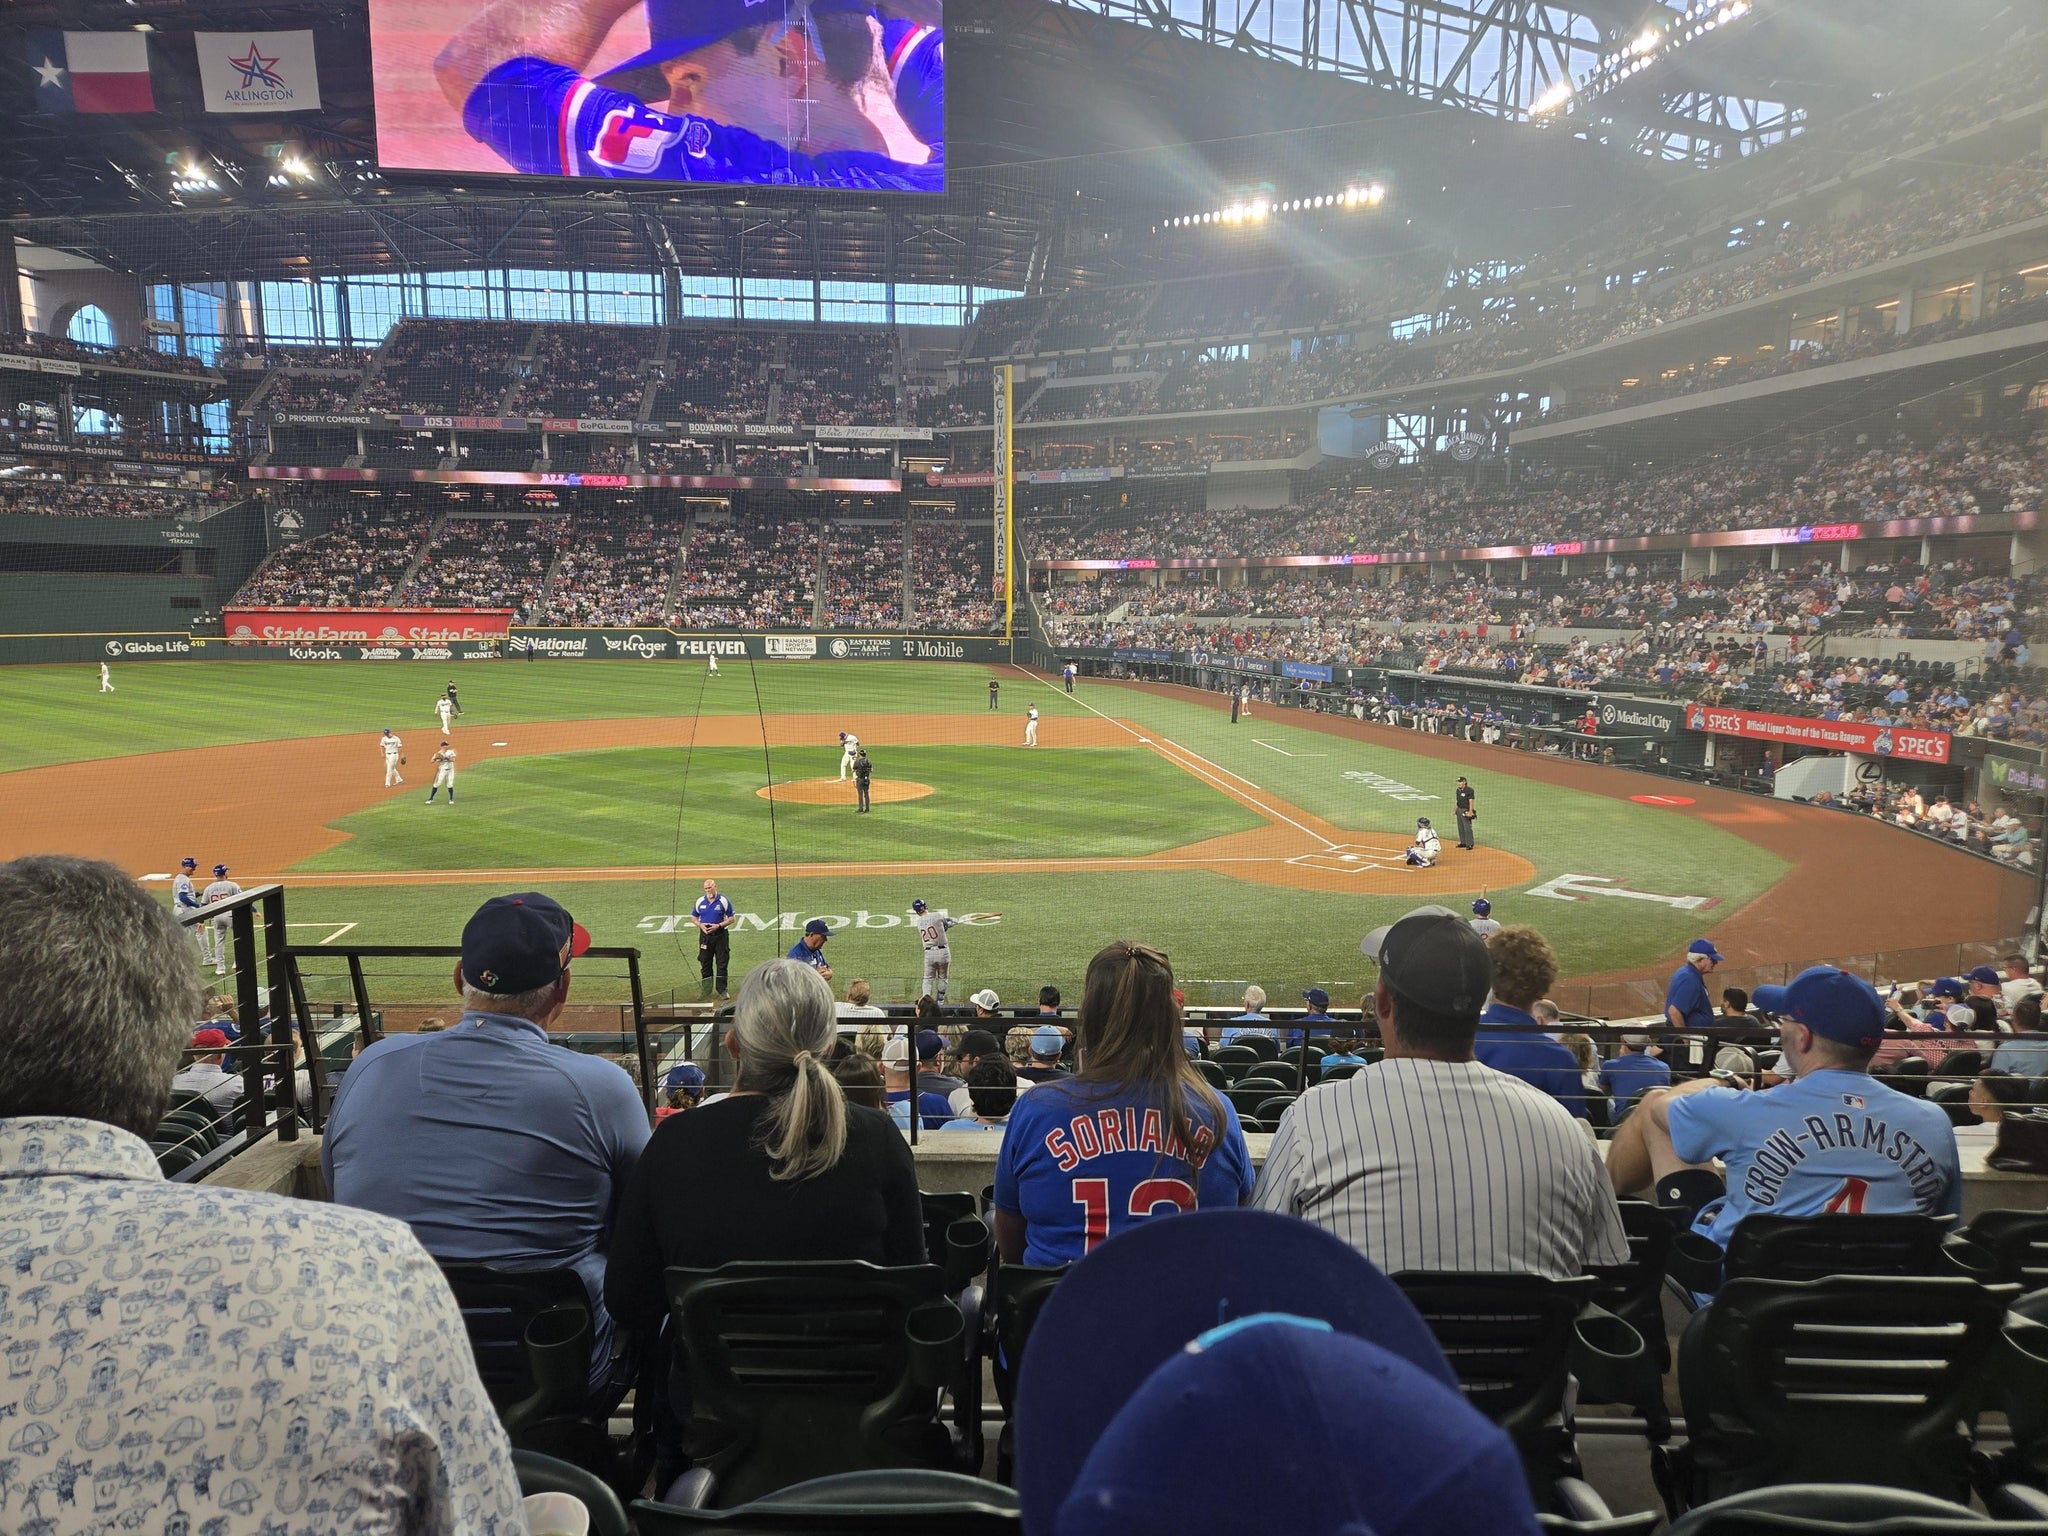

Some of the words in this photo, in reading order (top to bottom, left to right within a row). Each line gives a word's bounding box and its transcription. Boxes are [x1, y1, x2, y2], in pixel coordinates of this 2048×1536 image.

[225, 89, 293, 101] ARLINGTON
[289, 414, 325, 423] PRIORITY
[326, 415, 370, 424] COMMERCE
[424, 417, 452, 427] 105.3
[454, 417, 476, 429] THE
[478, 418, 502, 429] FAN
[552, 421, 574, 429] PGL
[580, 422, 629, 431] GoPGL.com
[642, 423, 664, 432] PGL
[688, 423, 738, 433] BODYARMOR
[744, 424, 794, 434] BODYARMOR
[817, 425, 842, 437] Blue
[21, 442, 70, 453] HARGROVE
[85, 446, 124, 456] ROOFING
[142, 450, 204, 462] PLUCKERS
[581, 474, 628, 486] TEXAS
[161, 531, 200, 539] TEREMANA
[1812, 524, 1858, 539] TEXAS
[124, 642, 163, 653] Globe
[165, 641, 190, 652] Life
[370, 648, 397, 656] ARROW
[421, 648, 448, 656] ARROW
[622, 634, 667, 659] Kroger
[917, 641, 963, 658] Mobile
[289, 647, 342, 660] Kubota
[1617, 710, 1652, 727] Medical
[1652, 714, 1672, 732] City
[1708, 713, 1742, 731] SPEC'S
[1746, 719, 1766, 732] Official
[1767, 722, 1785, 736] Liquor
[1785, 725, 1801, 737] Store
[1802, 727, 1810, 737] of
[1810, 727, 1820, 738] the
[1820, 728, 1839, 741] Texas
[1839, 730, 1866, 745] Rangers
[1898, 735, 1946, 757] SPEC'S
[920, 926, 938, 942] 20
